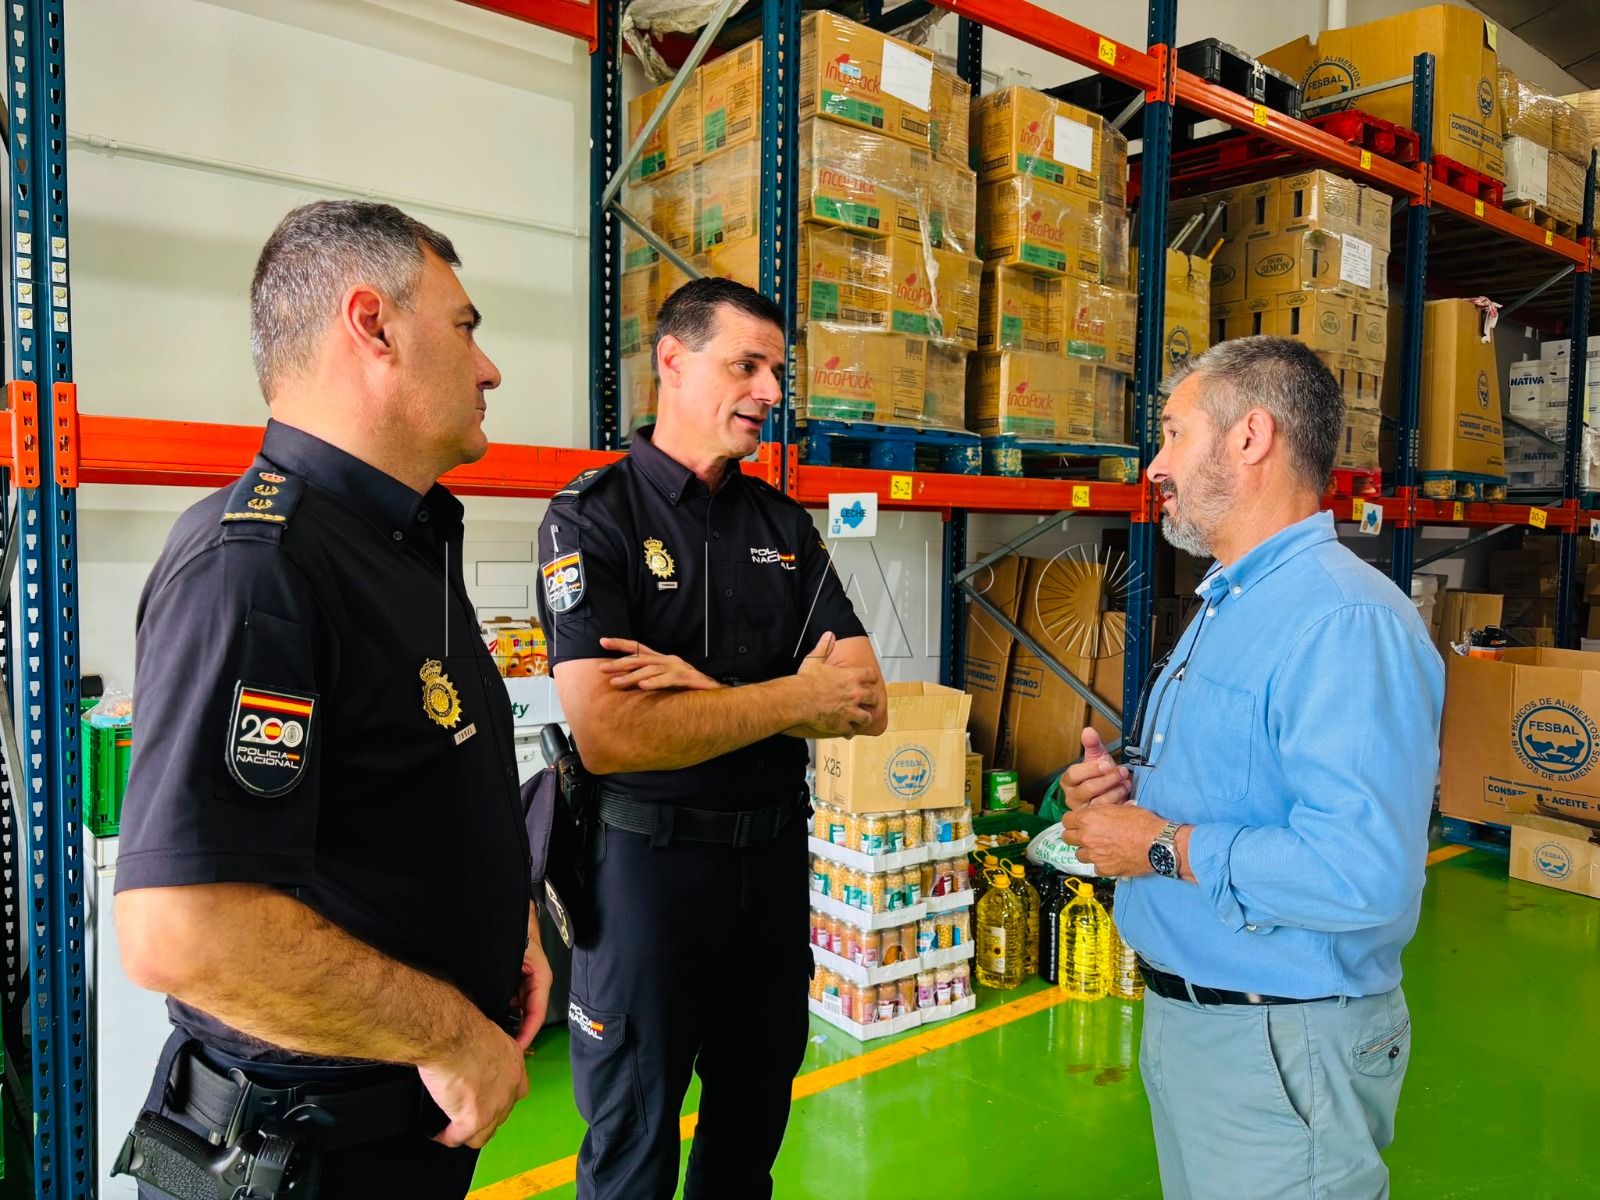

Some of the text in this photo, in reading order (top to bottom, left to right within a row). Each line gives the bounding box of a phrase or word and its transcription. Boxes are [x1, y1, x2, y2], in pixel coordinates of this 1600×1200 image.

[825, 61, 881, 95] Incoack
[1307, 74, 1345, 90] FESBAL
[1267, 255, 1284, 264] DON
[1261, 261, 1290, 274] SIMON
[812, 366, 874, 391] IncoPack
[1509, 375, 1545, 387] NATIVA
[1006, 390, 1054, 411] IncoPack
[1524, 451, 1559, 461] NATIVA
[893, 481, 911, 496] 5-2
[840, 508, 867, 518] LECHE
[1530, 511, 1546, 524] 10-2
[1512, 697, 1600, 740] BANCOS DE ALIMENTOS
[240, 714, 304, 748] 200
[1528, 720, 1579, 736] FESBAL
[237, 746, 288, 760] POLICIA
[236, 754, 299, 769] NACIONAL
[823, 754, 842, 778] X25
[1512, 740, 1600, 782] BANCOS DE ALIMENTOS
[1551, 796, 1589, 810] ACEITE
